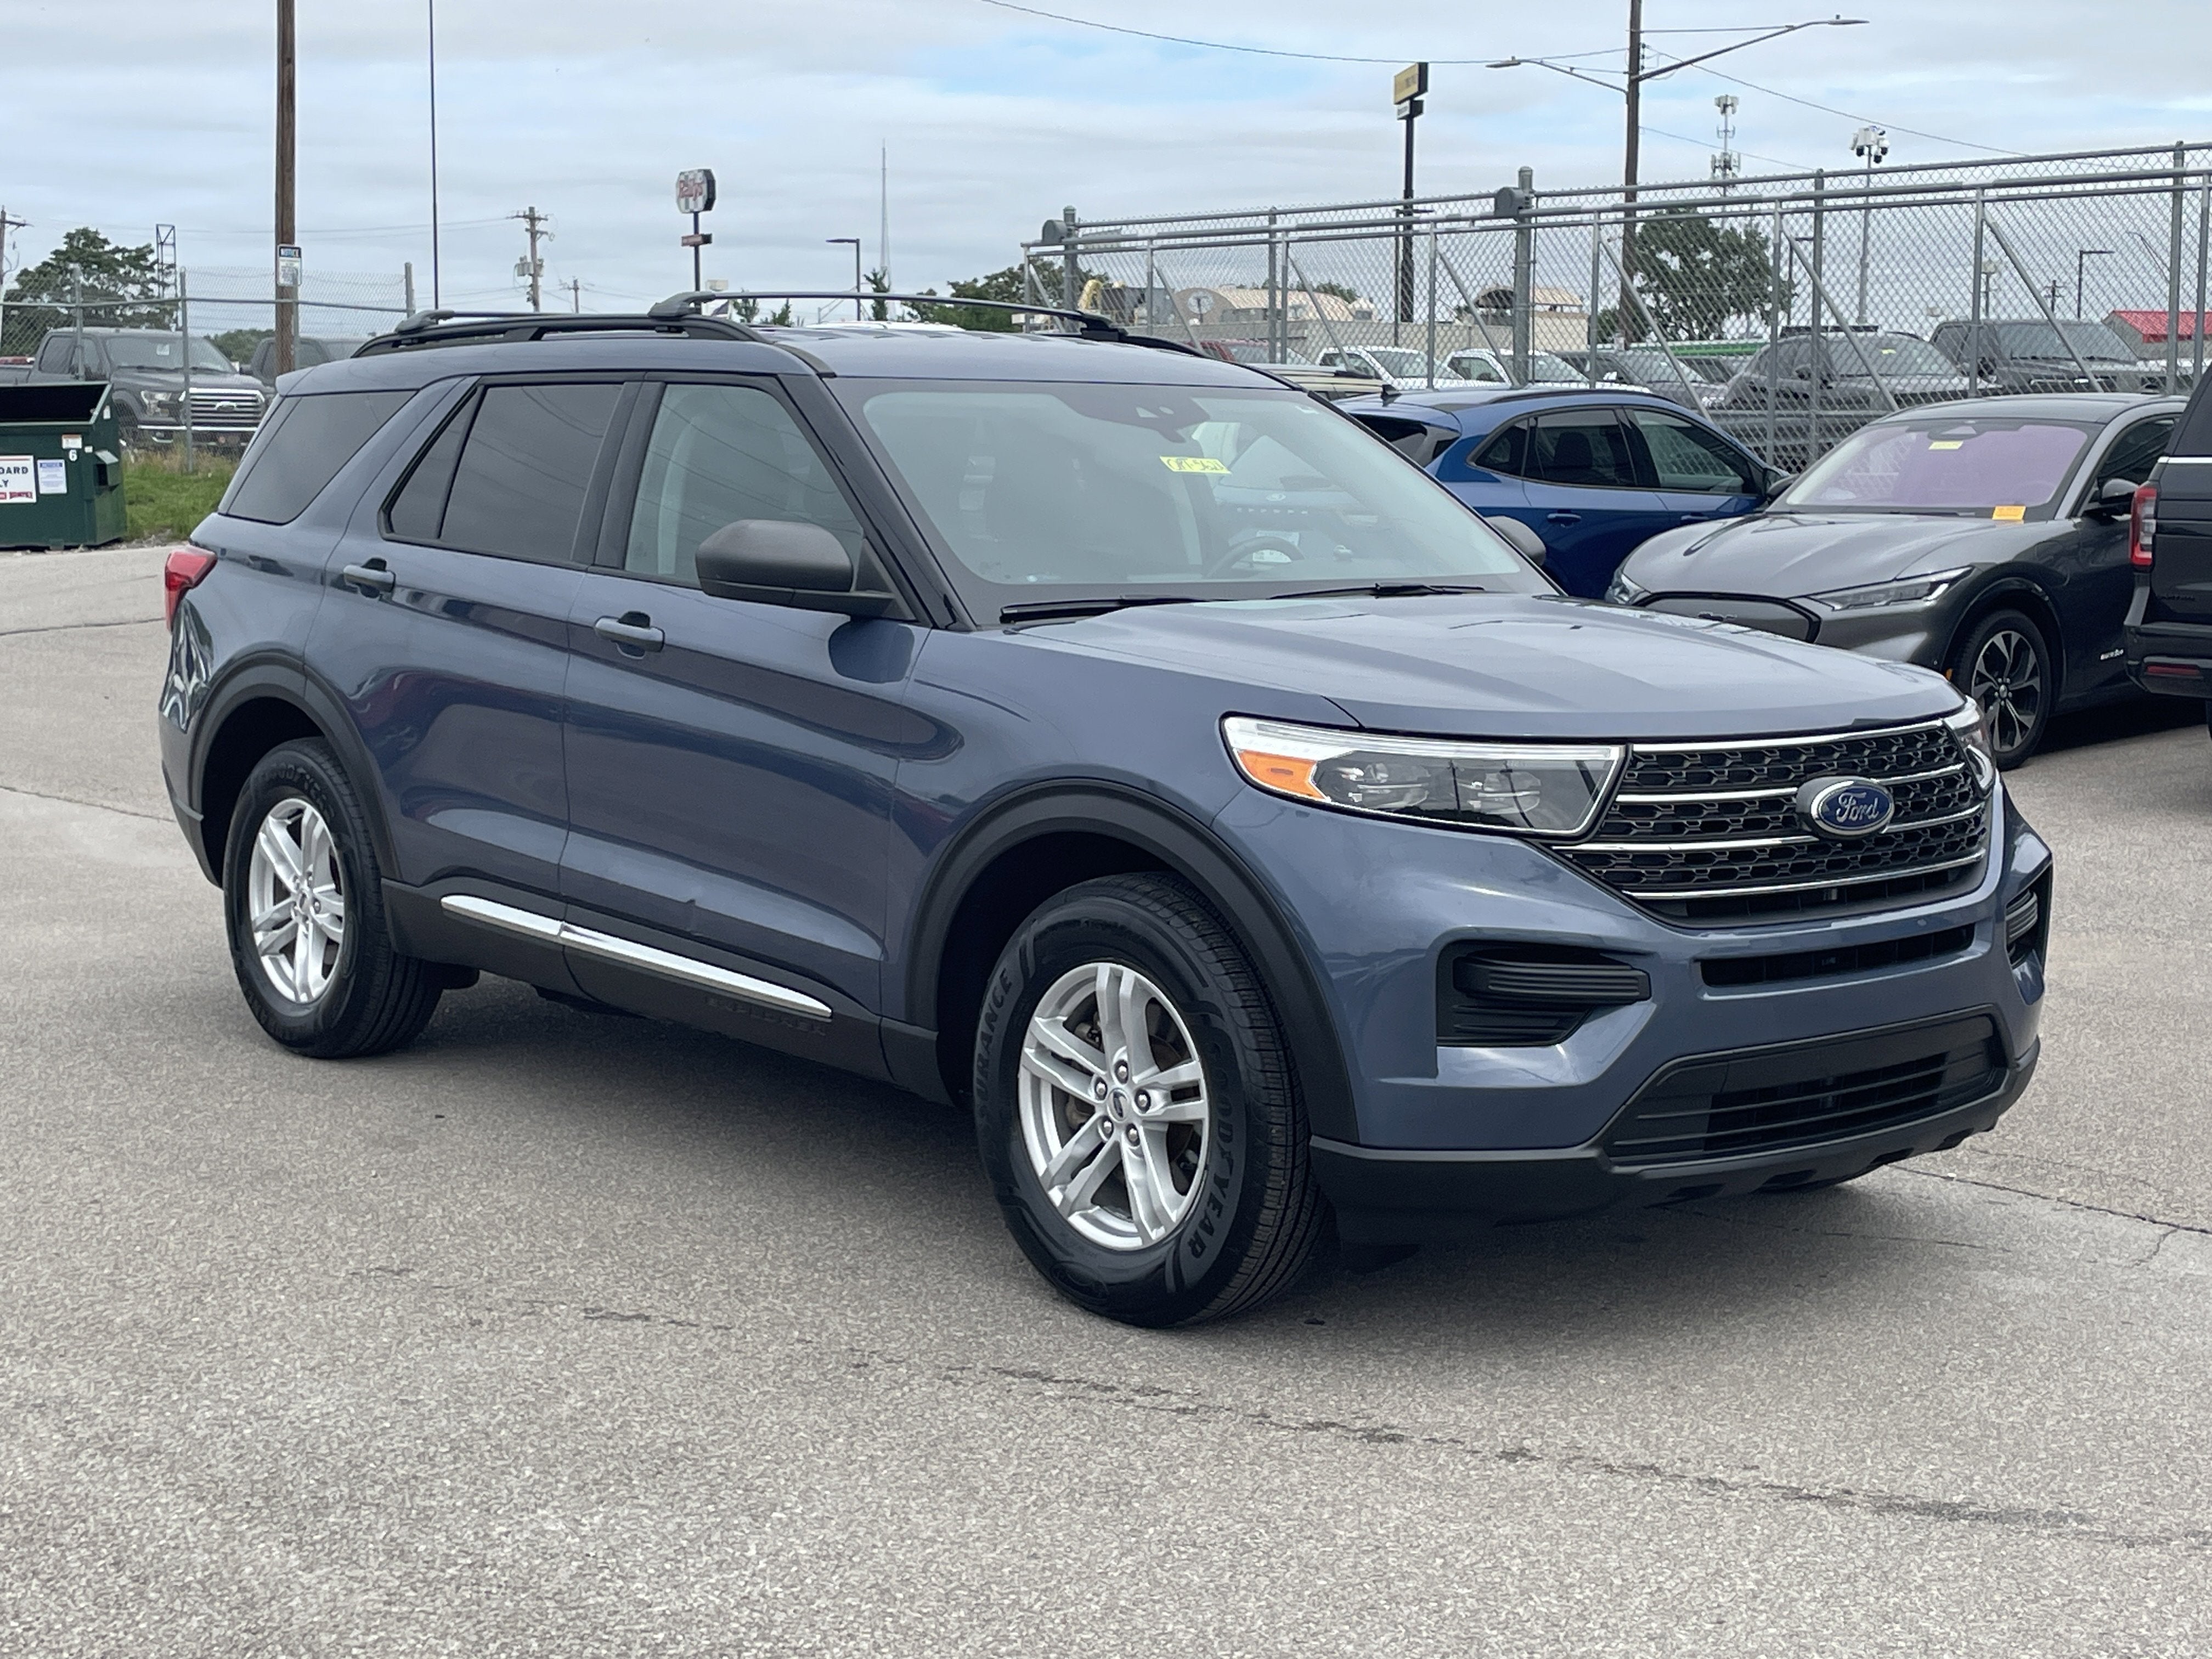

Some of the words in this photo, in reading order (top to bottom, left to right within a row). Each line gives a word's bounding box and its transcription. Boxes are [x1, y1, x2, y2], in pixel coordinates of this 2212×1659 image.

[69, 449, 77, 461] 6
[1836, 791, 1880, 823] Ford
[976, 967, 1013, 1159] SURANCE
[1187, 1041, 1234, 1260] GOODYEAR
